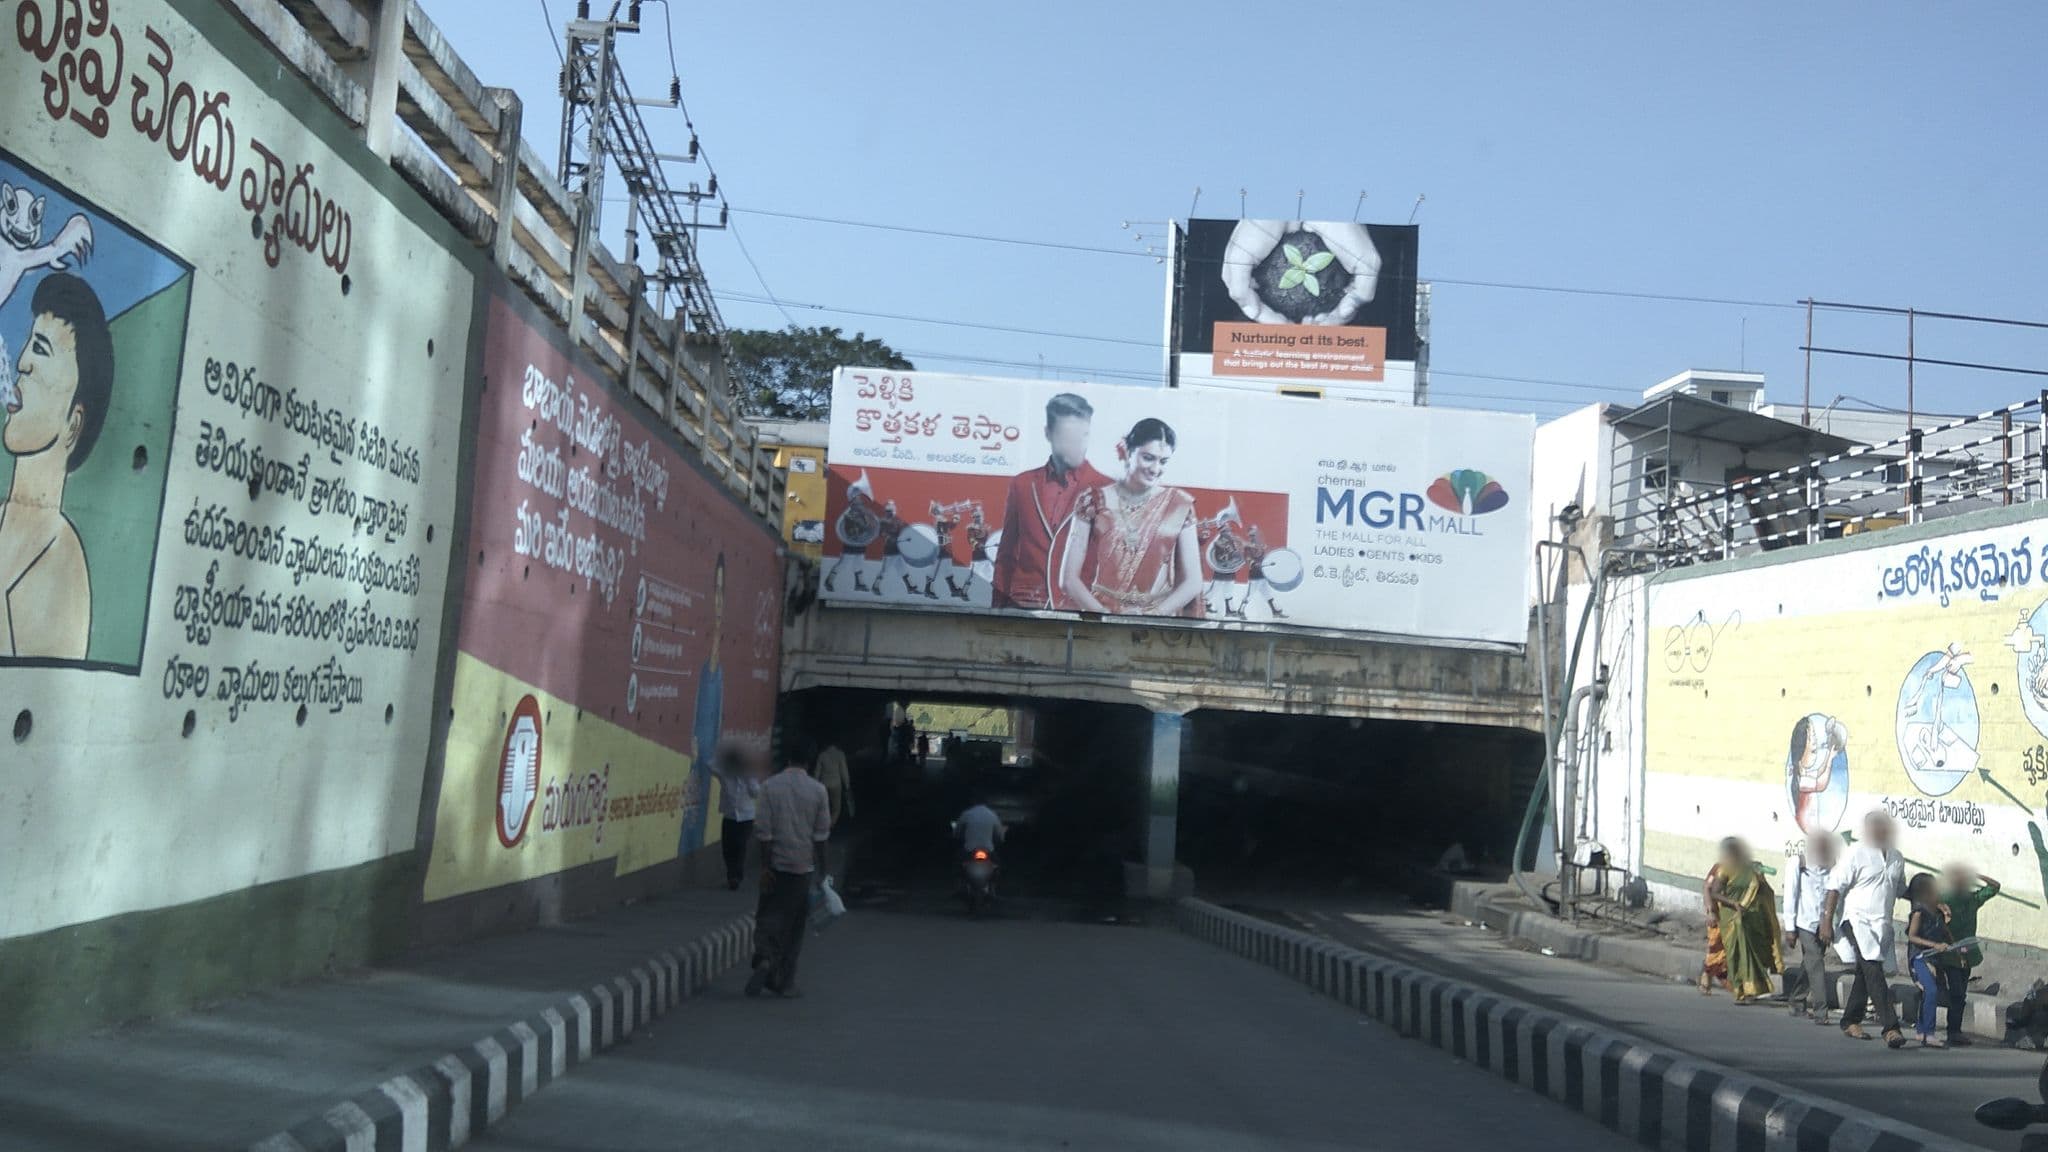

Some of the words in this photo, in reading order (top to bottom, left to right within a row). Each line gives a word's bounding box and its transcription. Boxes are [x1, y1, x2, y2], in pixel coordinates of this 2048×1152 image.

[131, 25, 235, 190] చెందు
[1231, 332, 1297, 347] Nurturing
[1299, 334, 1314, 345] at
[1317, 335, 1333, 346] its
[1337, 336, 1369, 348] best.
[1223, 359, 1241, 368] that
[1242, 360, 1268, 370] brings
[1269, 361, 1284, 369] out
[1285, 361, 1299, 370] the
[1300, 362, 1318, 370] best
[1319, 363, 1329, 371] in
[1329, 363, 1349, 373] your
[1275, 350, 1311, 361] learning
[1312, 352, 1366, 362] environment
[284, 387, 356, 464] కలుషితమైన
[389, 439, 421, 485] మనకు
[951, 414, 1021, 451] తెస్తాం
[1317, 474, 1366, 488] chennai
[1316, 486, 1426, 532] MGR
[1428, 514, 1485, 536] MALL
[1316, 529, 1338, 541] THE
[1342, 531, 1374, 544] MALL
[1376, 534, 1402, 545] FOR
[1405, 536, 1427, 547] ALL
[1314, 545, 1355, 558] LADIES
[1366, 548, 1405, 562] GENTS
[1415, 552, 1444, 565] KIDS
[1883, 535, 2033, 609] ఆరోగ్యకరమైన
[162, 653, 210, 700] రకాల
